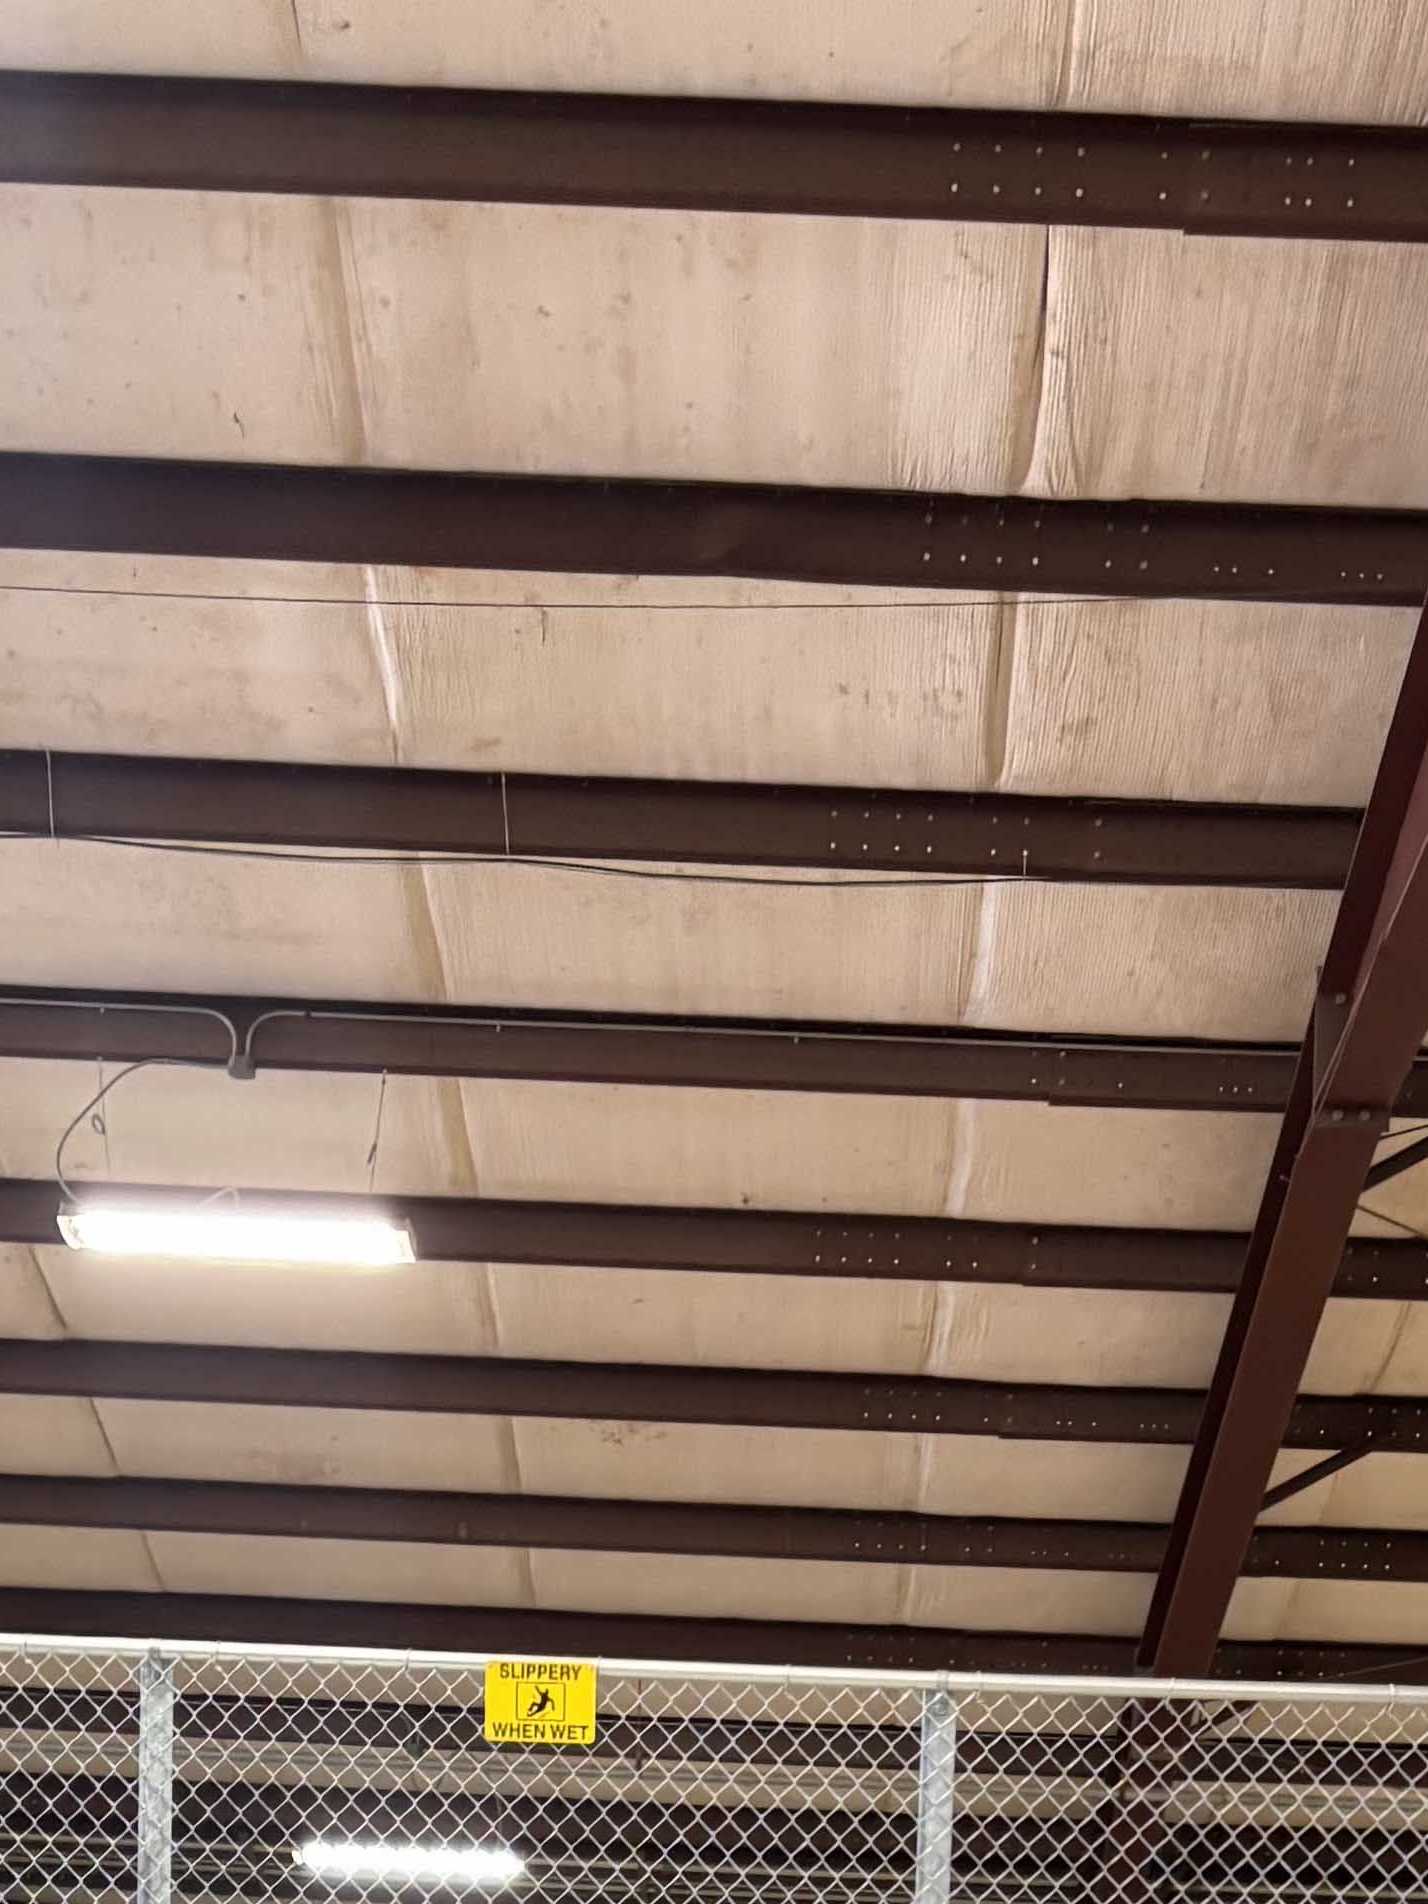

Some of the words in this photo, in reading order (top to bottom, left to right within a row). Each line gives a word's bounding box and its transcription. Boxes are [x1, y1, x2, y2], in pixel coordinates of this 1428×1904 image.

[500, 1662, 581, 1680] SLIPPERY
[493, 1721, 545, 1738] WHEN
[551, 1725, 588, 1739] WET
